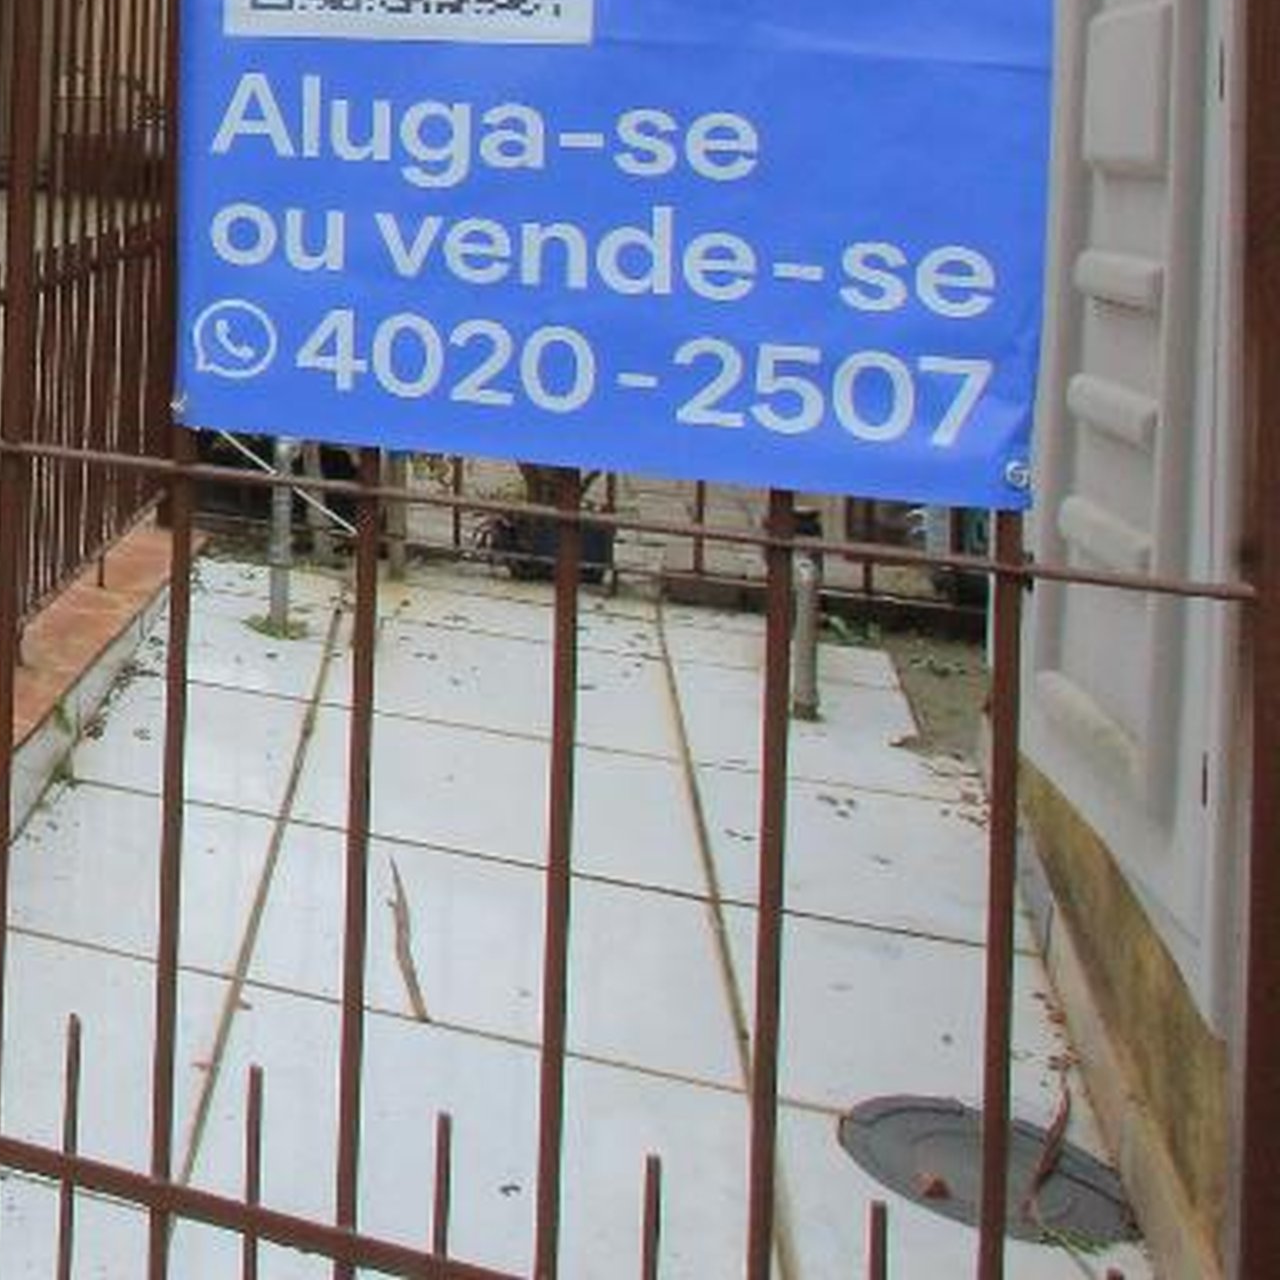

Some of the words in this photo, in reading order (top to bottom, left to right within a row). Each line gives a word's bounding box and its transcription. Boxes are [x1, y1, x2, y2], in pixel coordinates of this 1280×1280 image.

[211, 72, 760, 189] Aluga-se
[209, 200, 346, 270] ou
[375, 205, 997, 319] vende-se
